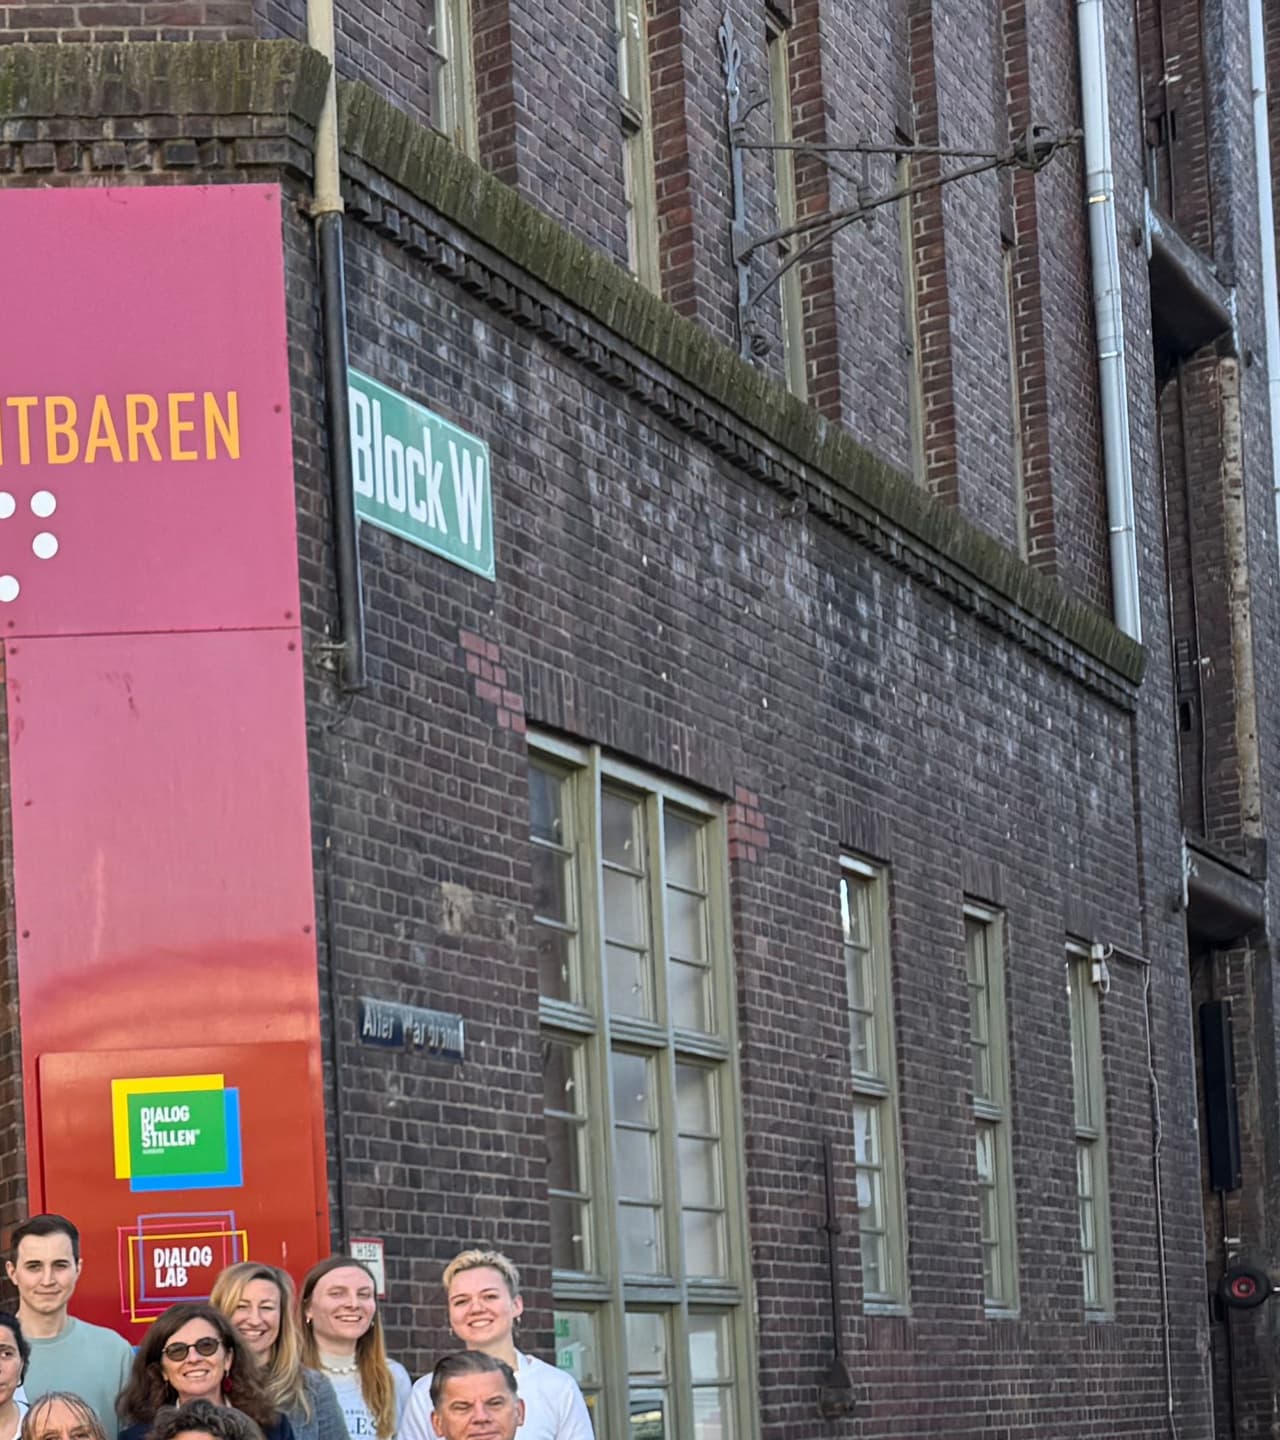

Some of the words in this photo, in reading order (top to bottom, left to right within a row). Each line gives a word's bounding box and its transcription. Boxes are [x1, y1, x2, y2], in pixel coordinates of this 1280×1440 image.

[349, 385, 448, 535] Block
[448, 439, 484, 552] W
[140, 1104, 190, 1123] DIALOG
[142, 1129, 200, 1148] STILLEN
[153, 1246, 213, 1268] DIALOG
[155, 1268, 189, 1288] LAB
